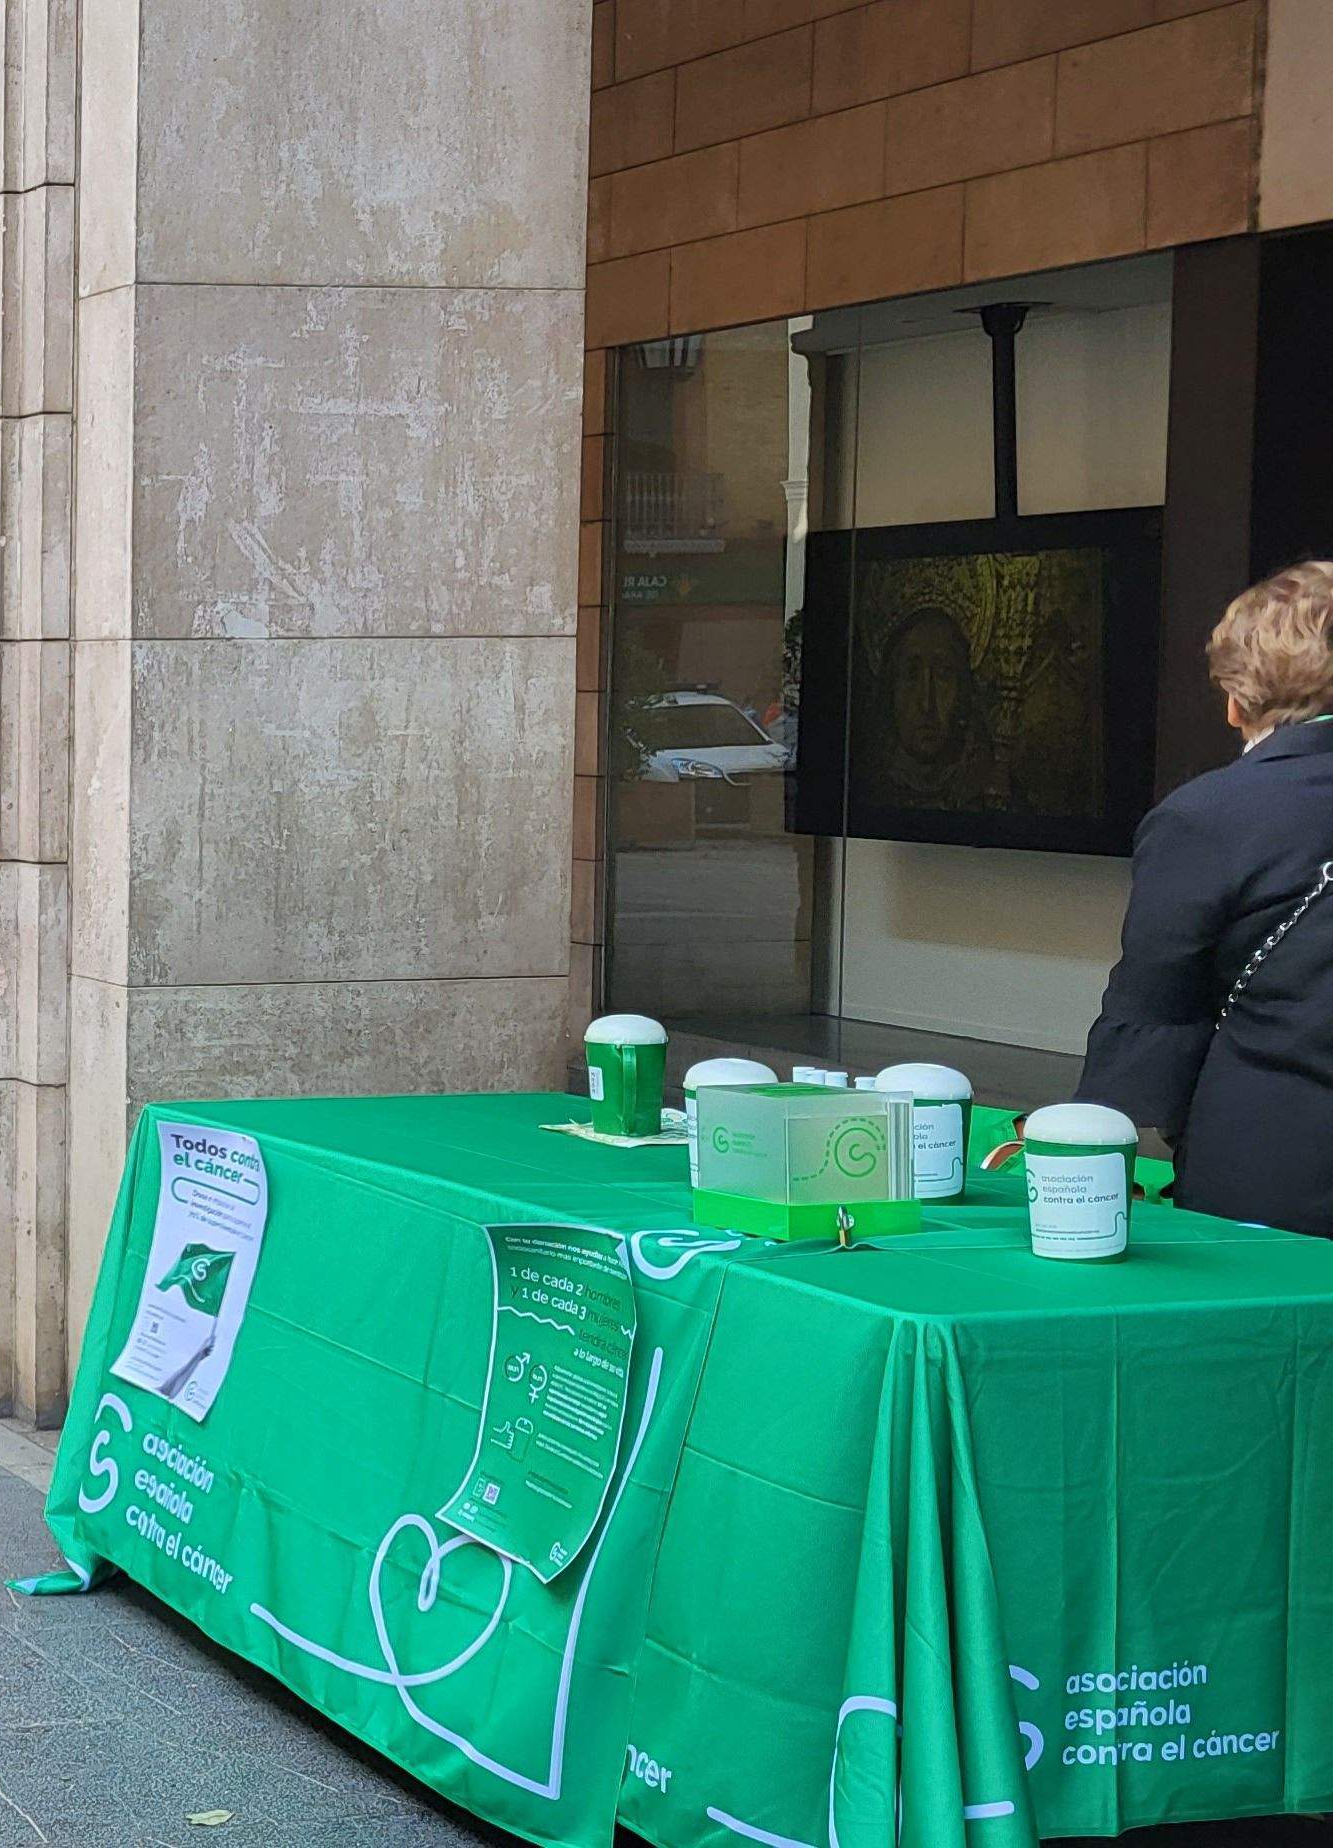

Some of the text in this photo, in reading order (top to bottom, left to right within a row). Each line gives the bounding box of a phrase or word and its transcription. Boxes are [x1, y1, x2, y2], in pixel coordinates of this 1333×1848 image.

[170, 1134, 260, 1172] Todos contra
[173, 1152, 243, 1184] el cáncer
[1042, 1174, 1093, 1183] asociación
[1042, 1185, 1087, 1195] española
[1043, 1193, 1119, 1205] contra el cáncer
[510, 1266, 518, 1278] 1
[520, 1267, 539, 1282] de
[543, 1272, 574, 1293] cada
[576, 1283, 584, 1297] 2
[522, 1287, 529, 1299] 1
[532, 1289, 548, 1305] de
[551, 1297, 578, 1315] cada
[579, 1306, 587, 1320] 3
[166, 1532, 182, 1560] el
[182, 1545, 233, 1594] cáncer
[1066, 1660, 1207, 1694] asociación
[1064, 1700, 1191, 1735] española
[1062, 1730, 1280, 1766] conra el cáncer
